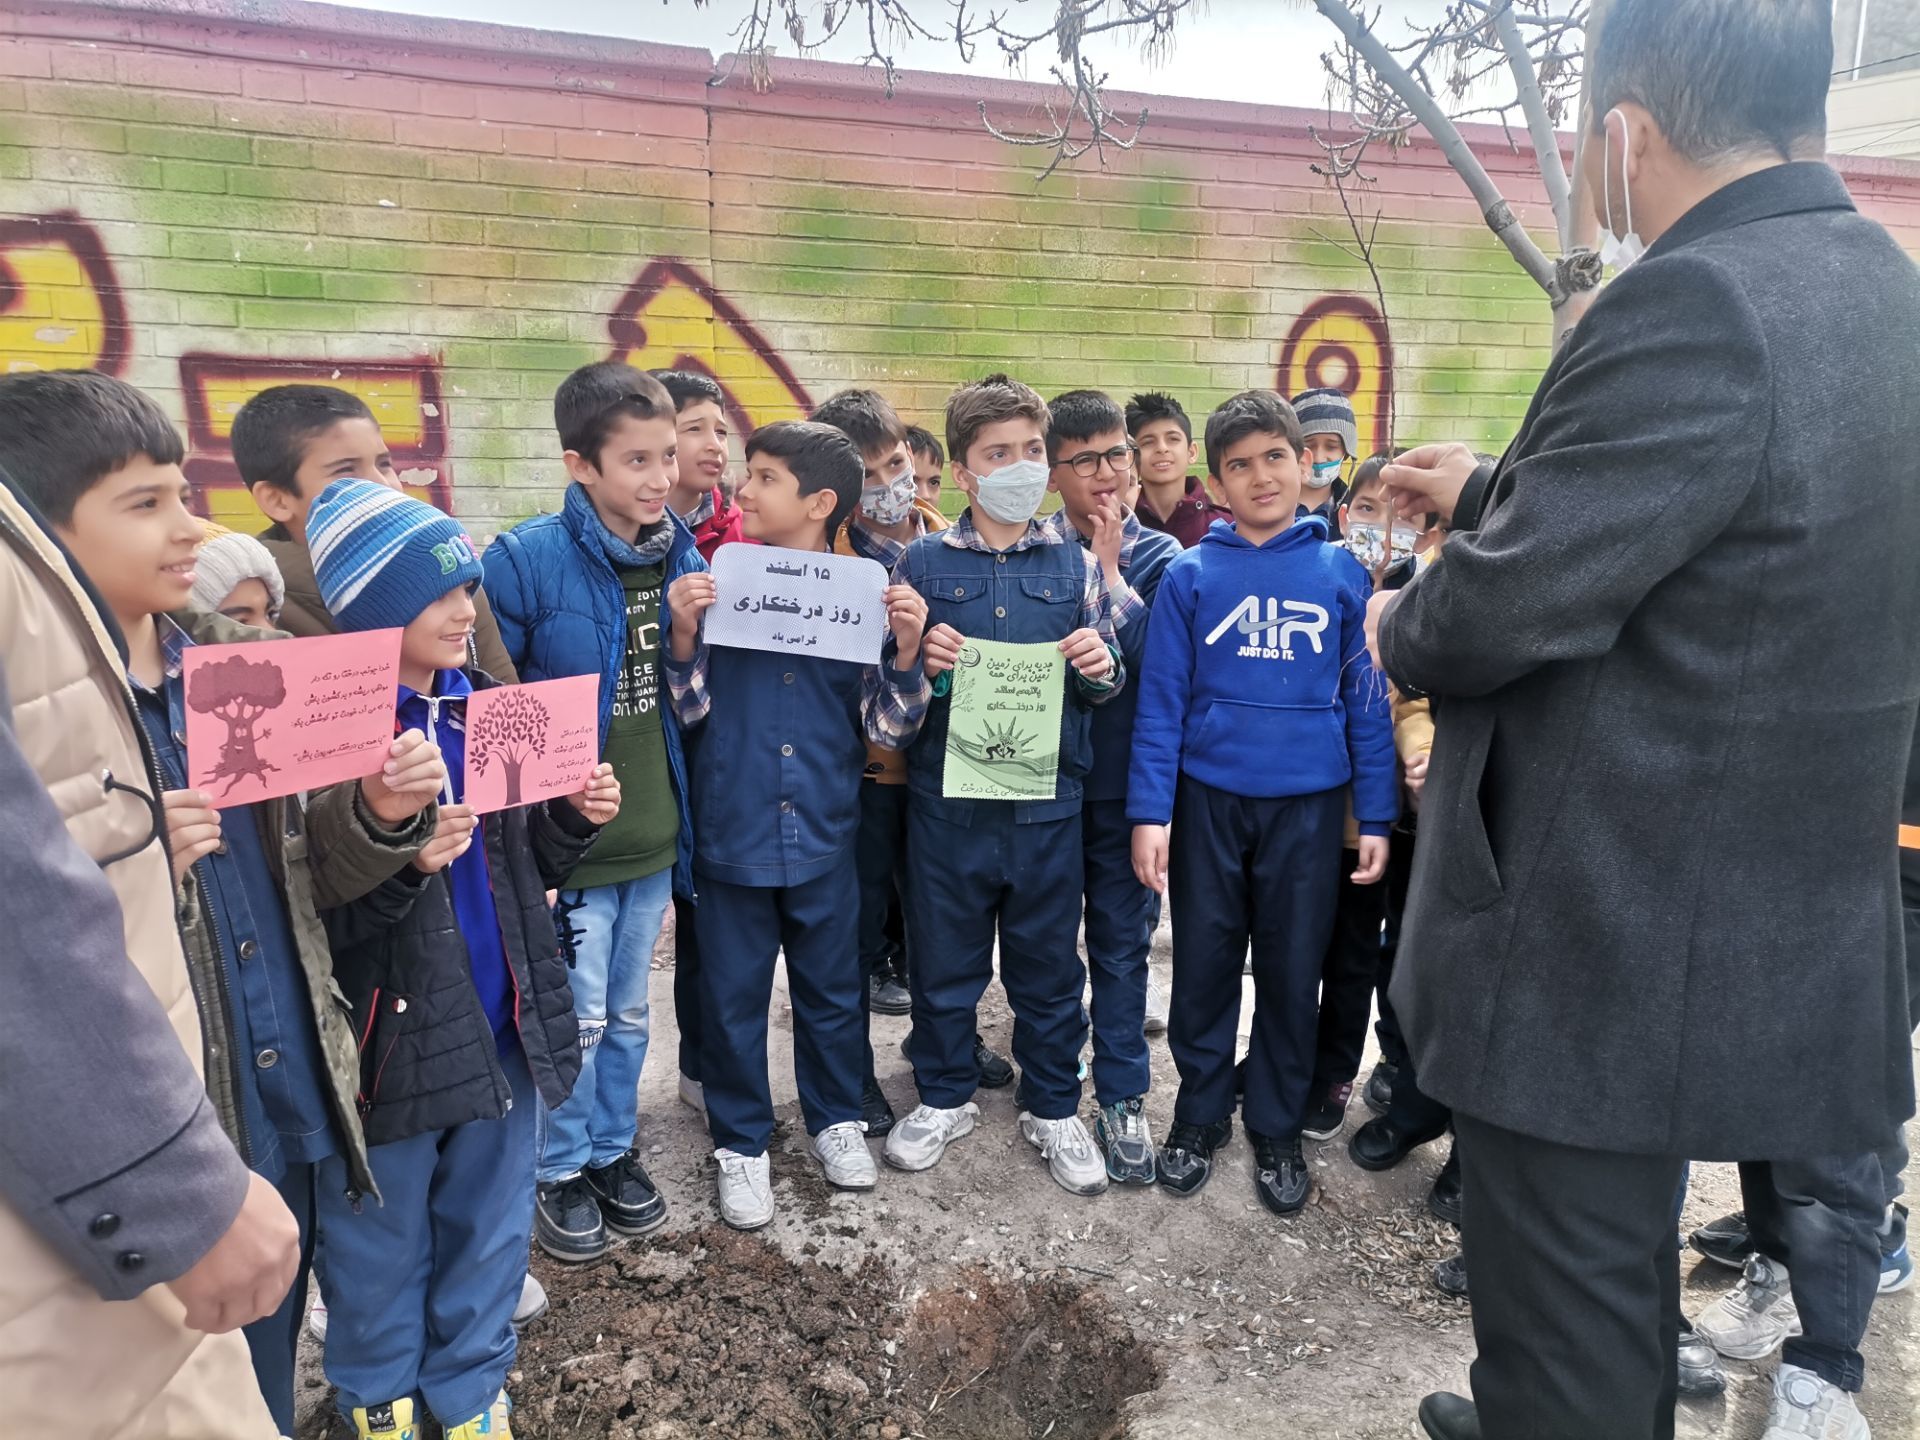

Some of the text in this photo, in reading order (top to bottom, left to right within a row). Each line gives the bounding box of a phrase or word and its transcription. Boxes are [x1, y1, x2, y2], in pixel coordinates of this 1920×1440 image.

[765, 560, 831, 580] ۱۵ اسفند
[733, 594, 862, 626] روز درختکاری
[1205, 595, 1329, 654] AIR
[772, 631, 818, 646] گرامی باد
[1237, 645, 1262, 658] JUST
[1262, 648, 1280, 660] DO
[379, 663, 390, 672] خدا
[986, 657, 1011, 670] زمین
[1012, 660, 1033, 673] برای
[988, 669, 1050, 683] زمین برای همه
[304, 693, 320, 707] باش
[1035, 702, 1047, 713] روز
[331, 711, 339, 721] تو
[960, 783, 983, 794] درخت
[985, 784, 999, 797] یک
